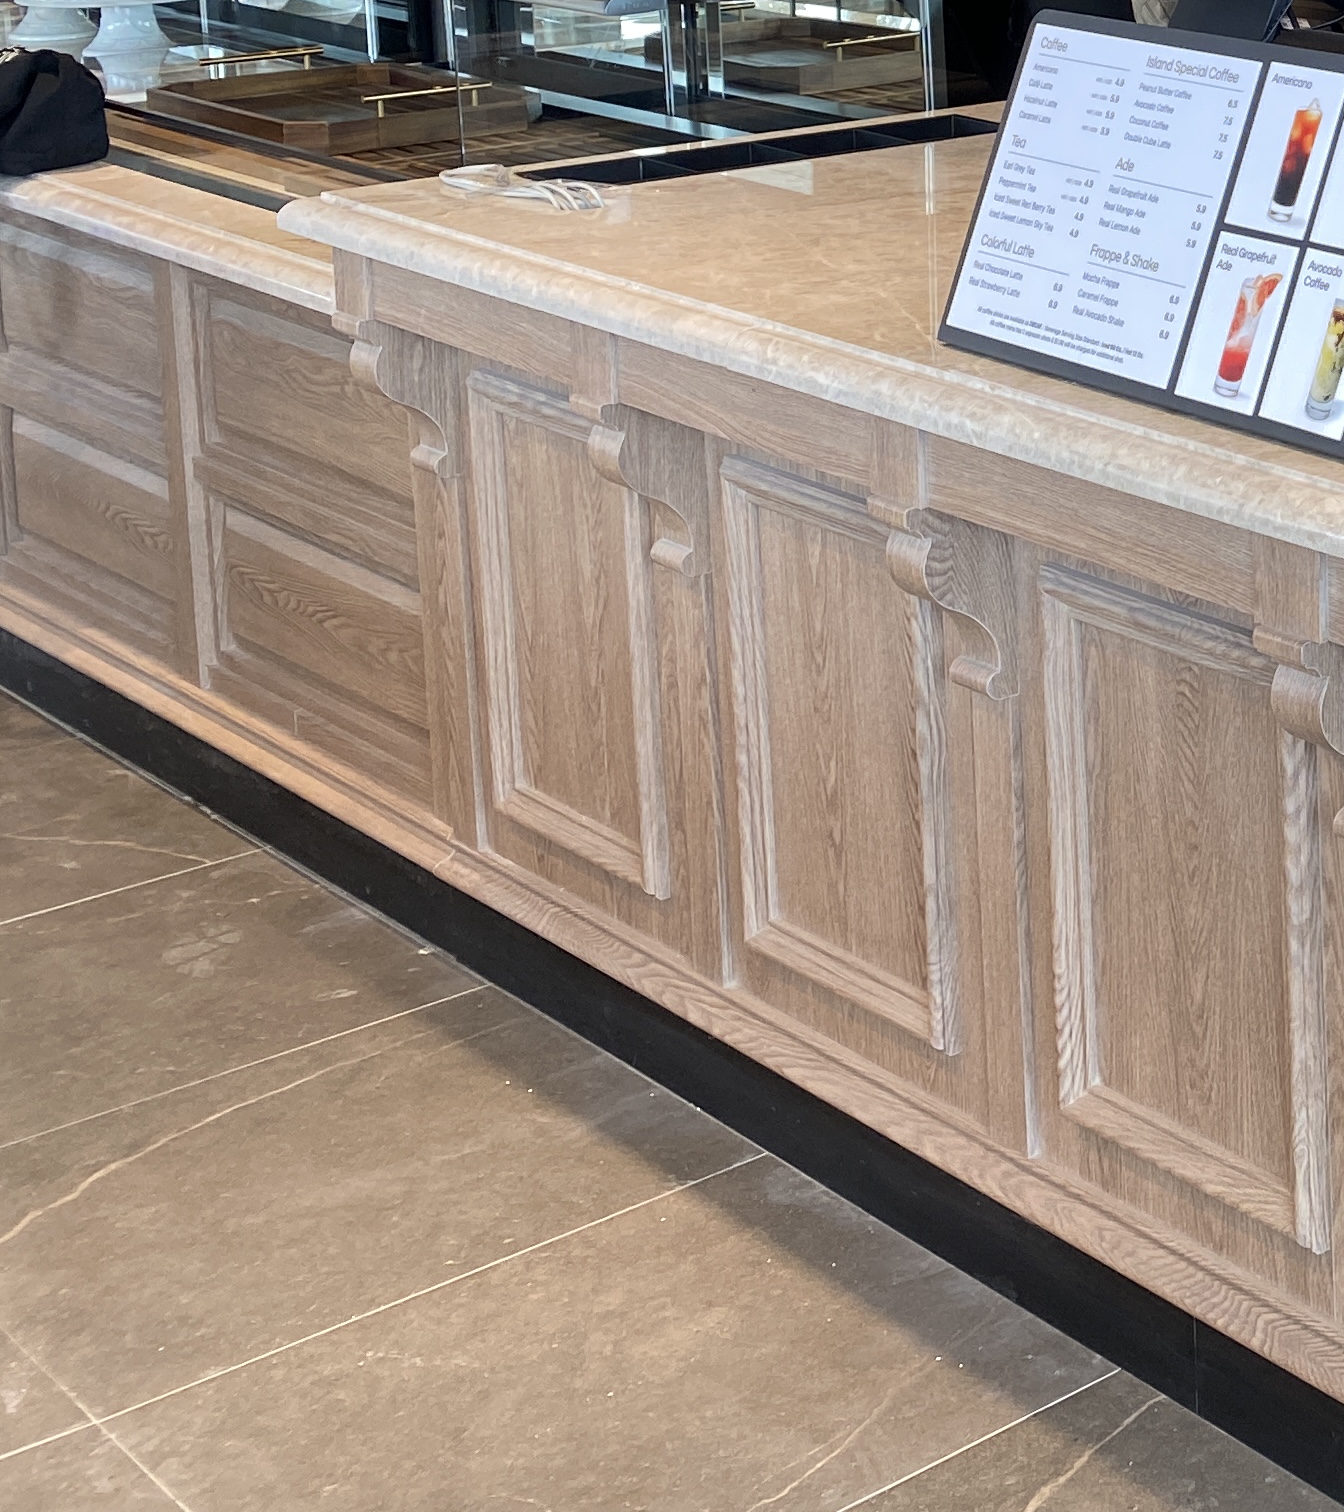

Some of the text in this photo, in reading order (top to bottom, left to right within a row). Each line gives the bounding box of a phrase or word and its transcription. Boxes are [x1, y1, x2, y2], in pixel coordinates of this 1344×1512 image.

[1040, 36, 1068, 52] Coffee
[1145, 54, 1239, 83] Island Special Coffee
[1114, 77, 1124, 87] 4.9
[1271, 72, 1312, 89] Americano
[1156, 103, 1174, 114] Coffee
[1222, 115, 1233, 125] 7.5
[1128, 114, 1228, 143] Coconut Coffee 7.5
[1011, 134, 1026, 148] Tea
[1123, 131, 1223, 160] Double Cube Latte 7.5
[1002, 159, 1014, 169] Earl
[1013, 162, 1026, 174] Grey
[1026, 164, 1035, 175] Tea
[1083, 178, 1094, 188] 4.9
[1114, 156, 1134, 172] Ade
[1026, 182, 1036, 193] Tea
[1078, 195, 1089, 205] 4.9
[1108, 183, 1121, 194] Real
[1146, 193, 1159, 203] Ade
[1195, 203, 1206, 214] 5.9
[993, 192, 1005, 202] Iced
[1020, 198, 1031, 209] Red
[1031, 201, 1045, 214] Berry
[1045, 204, 1055, 215] Tea
[1073, 211, 1084, 221] 4.9
[1103, 200, 1116, 211] Real
[1115, 203, 1134, 217] Mango
[1133, 208, 1146, 218] Ade
[988, 209, 1000, 219] Iced
[1015, 216, 1033, 226] Lemon
[1044, 221, 1053, 232] Tea
[1068, 228, 1079, 238] 4.9
[1098, 216, 1111, 227] Real
[1110, 220, 1129, 232] Lemon
[1128, 224, 1140, 235] Ade
[980, 233, 1034, 258] Colorful Latte
[1220, 243, 1276, 265] Real Grapefruit
[1089, 243, 1159, 272] Frappe & Shake
[1215, 258, 1232, 271] Ade
[1306, 259, 1342, 277] Avocado
[1303, 275, 1330, 291] Coffee
